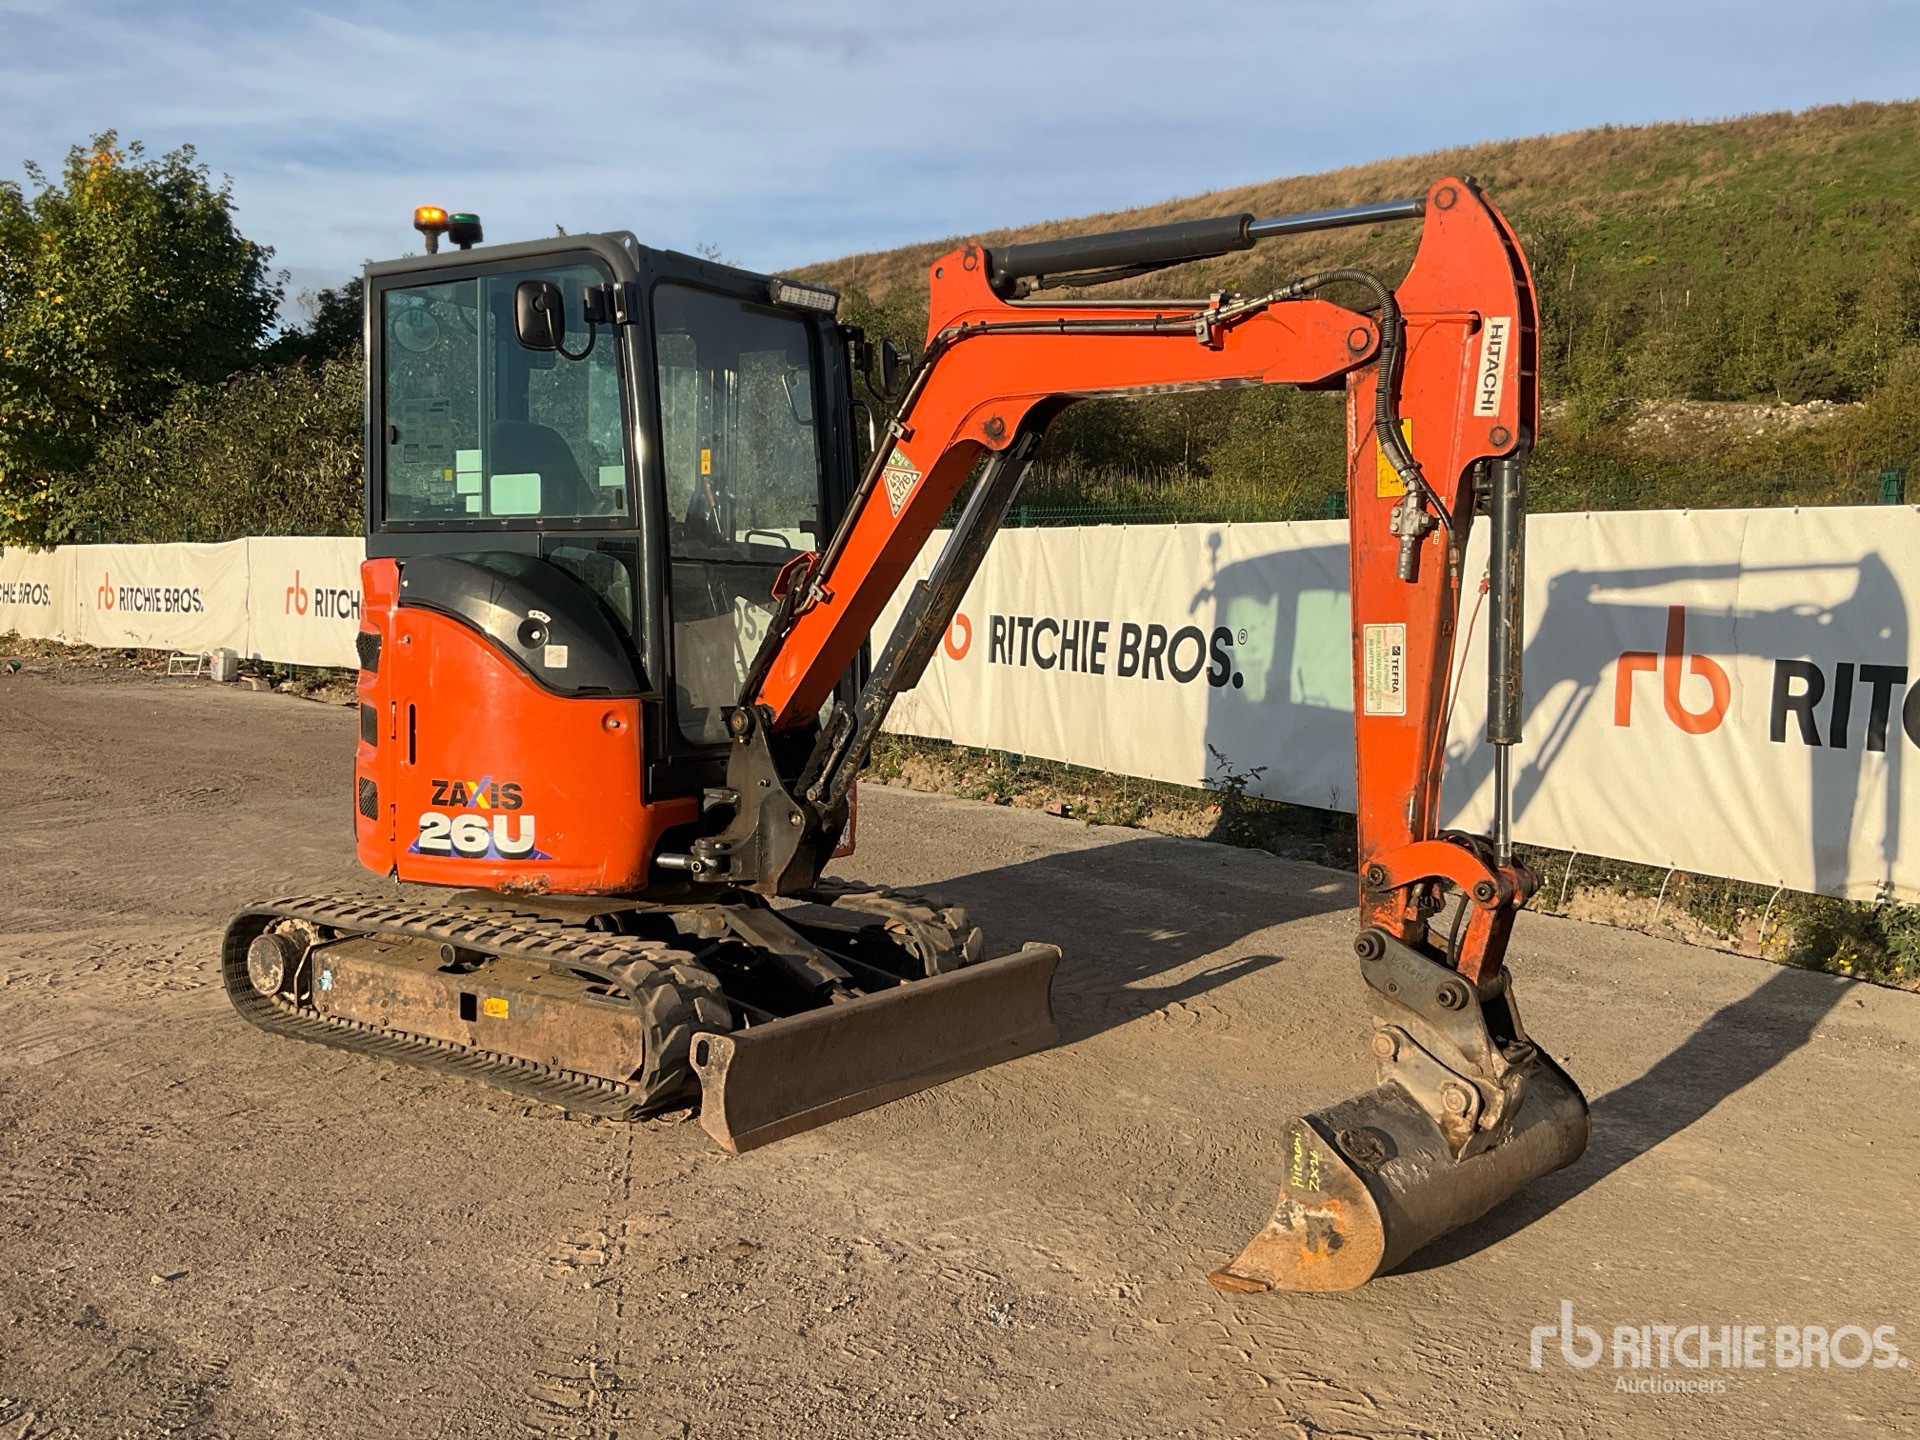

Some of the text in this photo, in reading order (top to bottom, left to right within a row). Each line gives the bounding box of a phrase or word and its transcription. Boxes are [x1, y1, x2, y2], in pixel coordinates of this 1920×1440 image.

[1481, 324, 1503, 411] HITACHI
[890, 473, 901, 488] 45
[119, 587, 161, 612] RITCHIE
[164, 587, 204, 613] BROS.
[988, 614, 1110, 675] RITCHIE
[1770, 658, 1920, 753] RIT
[431, 775, 524, 810] ZAXIS
[418, 812, 535, 859] 26U
